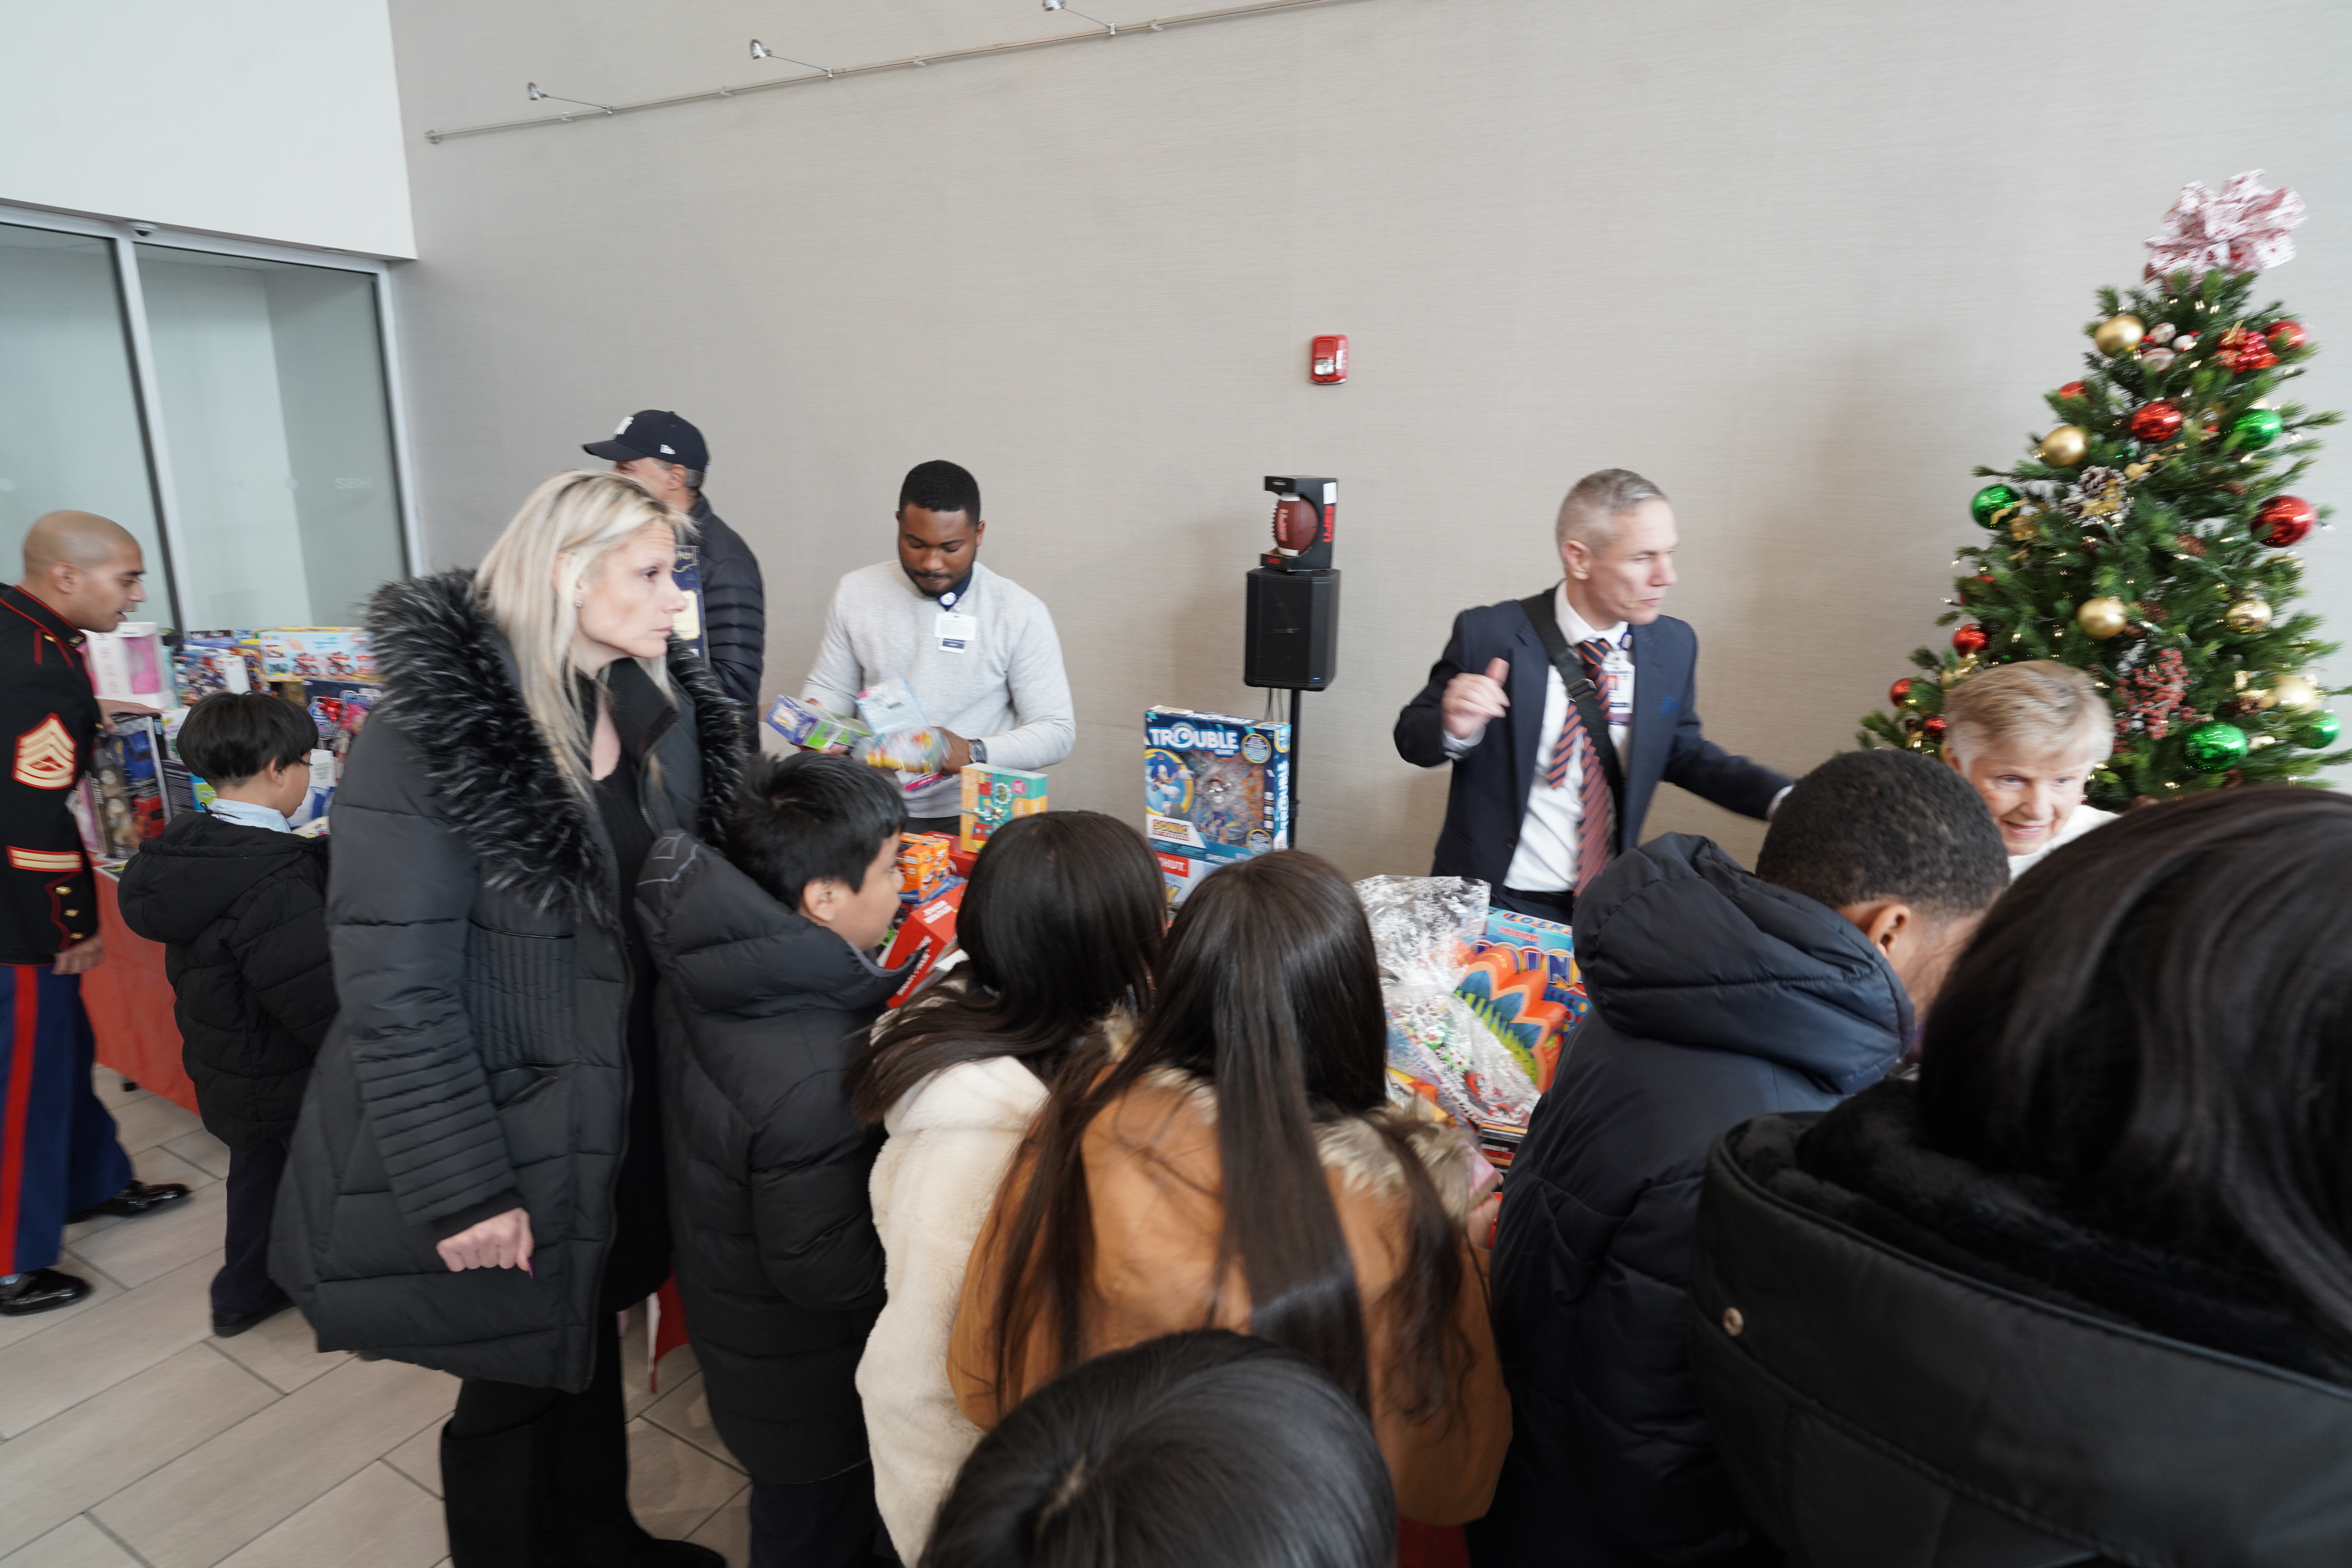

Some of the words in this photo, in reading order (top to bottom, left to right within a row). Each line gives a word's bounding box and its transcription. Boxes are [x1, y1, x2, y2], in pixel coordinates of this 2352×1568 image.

[1187, 713, 1256, 723] TROUBLE
[1148, 727, 1239, 749] TROUBLE
[1152, 819, 1188, 835] SONIC
